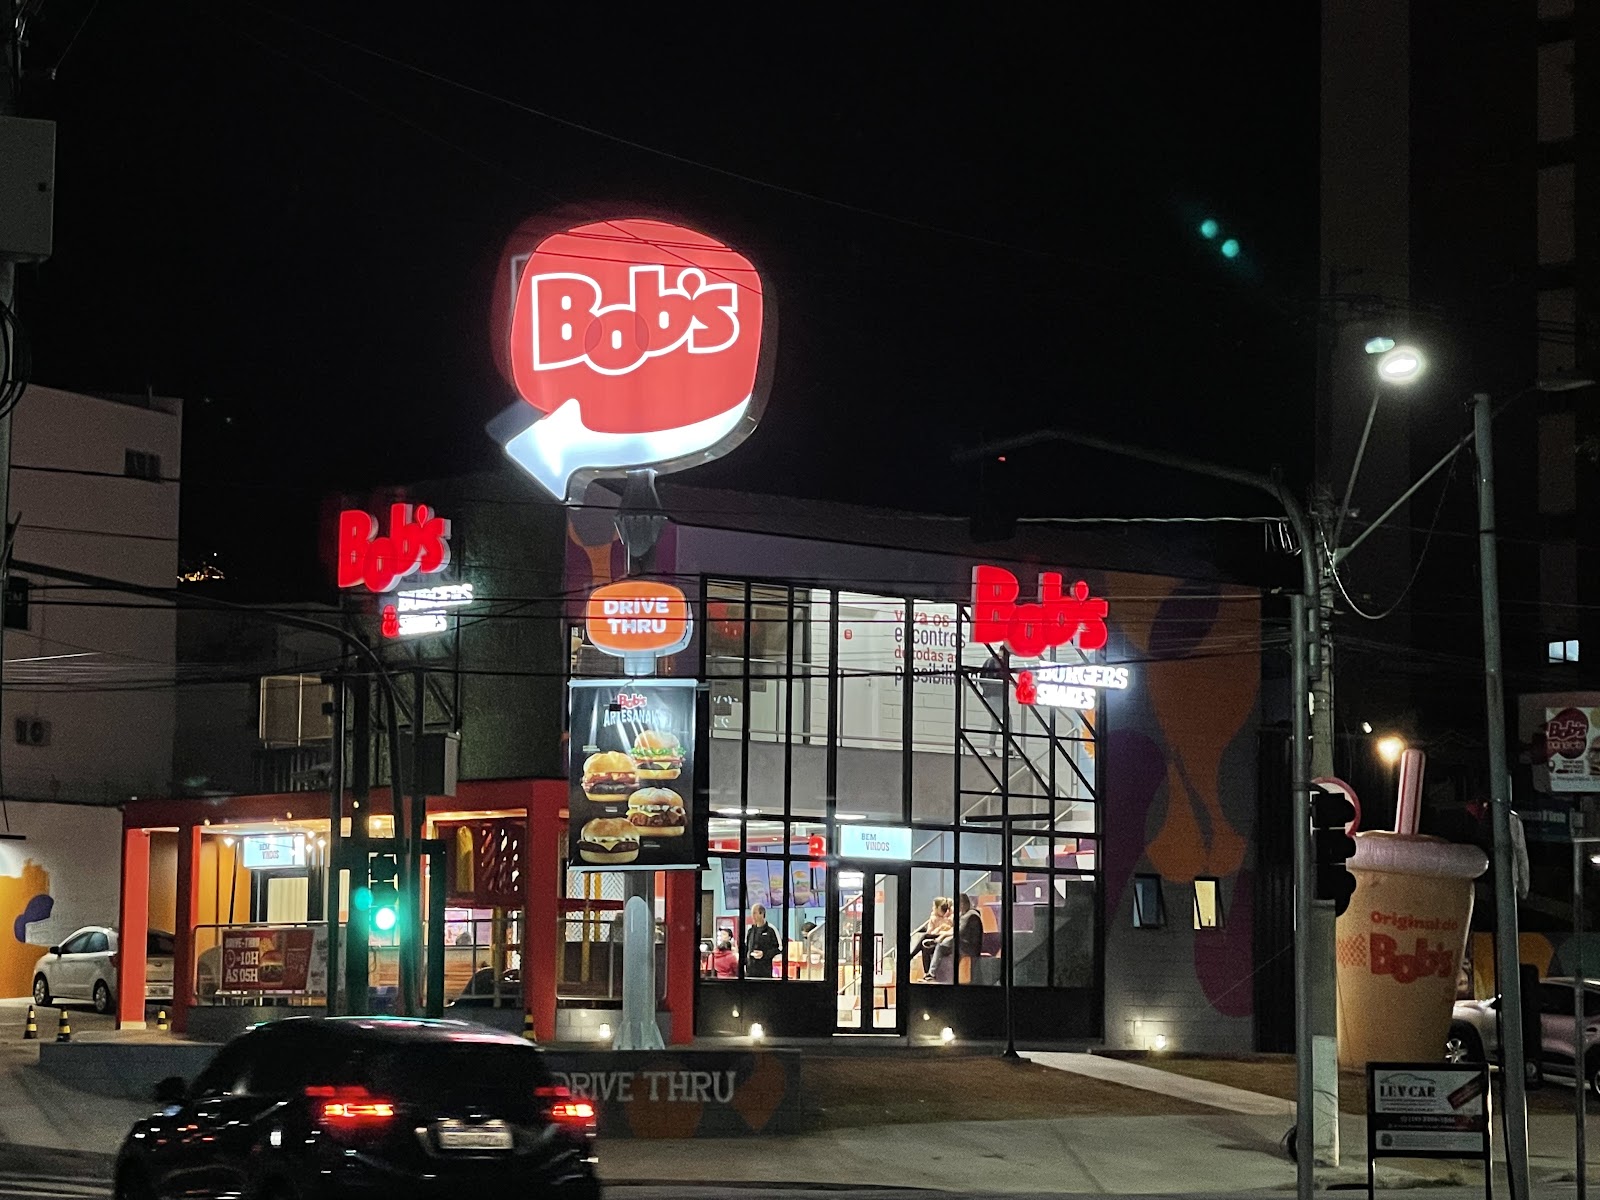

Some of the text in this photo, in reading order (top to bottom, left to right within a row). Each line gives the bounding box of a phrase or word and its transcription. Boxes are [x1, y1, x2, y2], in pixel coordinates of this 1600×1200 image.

[532, 265, 740, 376] Bob's
[338, 502, 452, 593] Bob's
[603, 597, 670, 615] DRIVE
[970, 565, 1109, 658] Bob's
[607, 618, 667, 635] THRU
[894, 627, 967, 649] econtros
[617, 692, 647, 710] Bob's
[861, 833, 877, 841] BEM
[1371, 910, 1439, 931] Original
[1370, 932, 1453, 985] Bob's
[643, 1071, 736, 1103] THRU
